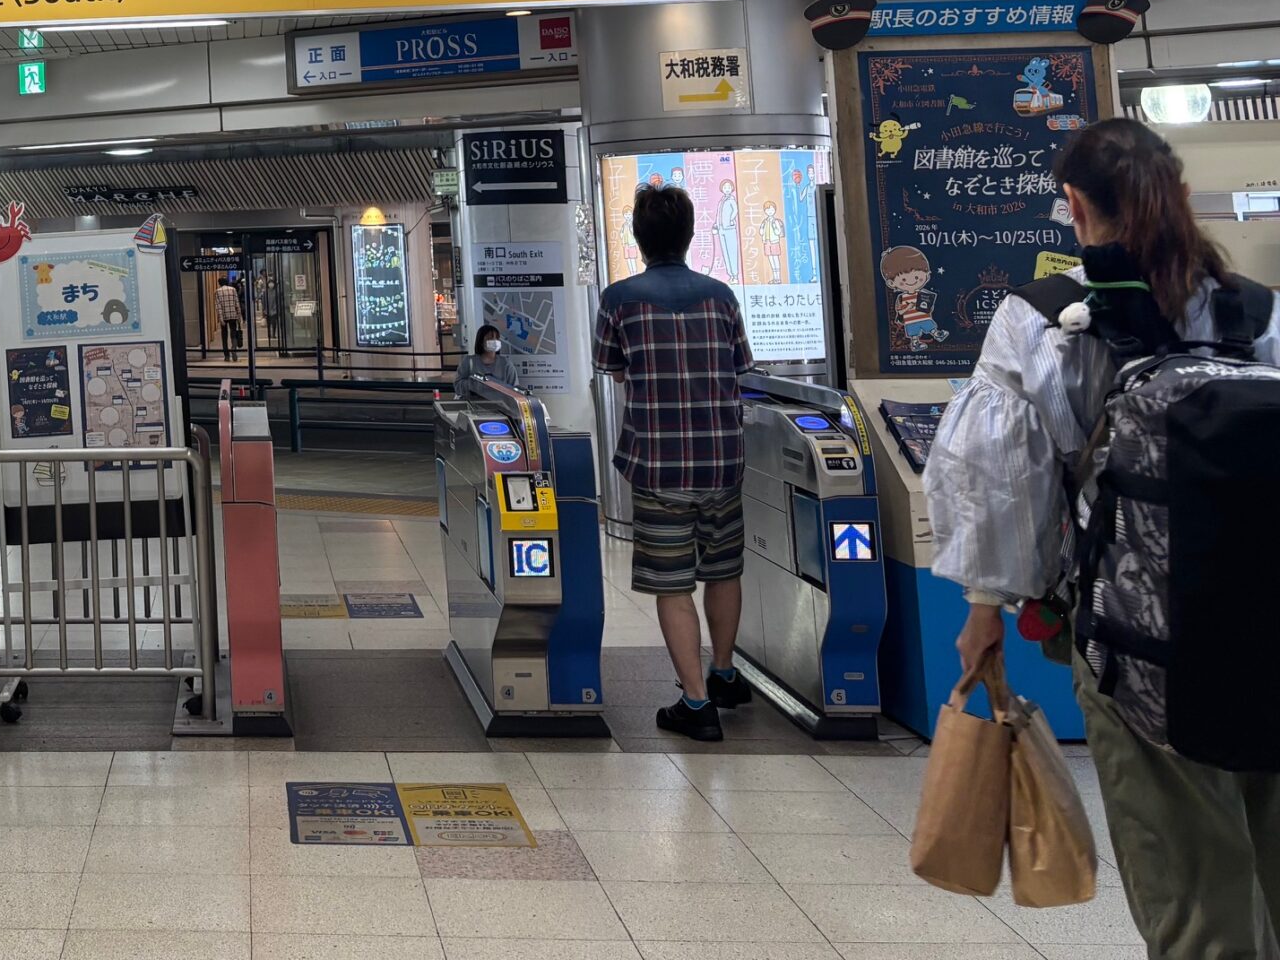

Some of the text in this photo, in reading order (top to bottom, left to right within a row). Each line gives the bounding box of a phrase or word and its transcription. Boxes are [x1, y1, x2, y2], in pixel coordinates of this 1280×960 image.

[870, 4, 1074, 29] 駅長のおすすめ情報
[541, 27, 569, 37] DAISO
[308, 44, 346, 65] 正面
[396, 33, 478, 62] PROSS
[547, 51, 568, 63] 入口
[319, 70, 337, 81] 入口
[665, 56, 740, 79] 大和税務署
[471, 138, 554, 161] SiRiUS
[914, 147, 1044, 170] 図書館を巡って
[945, 173, 1057, 196] なぞとき探検
[953, 201, 1026, 215] in 大和市 2026
[484, 247, 543, 259] 南口 South Exit
[62, 283, 99, 303] まち
[513, 543, 549, 575] IC
